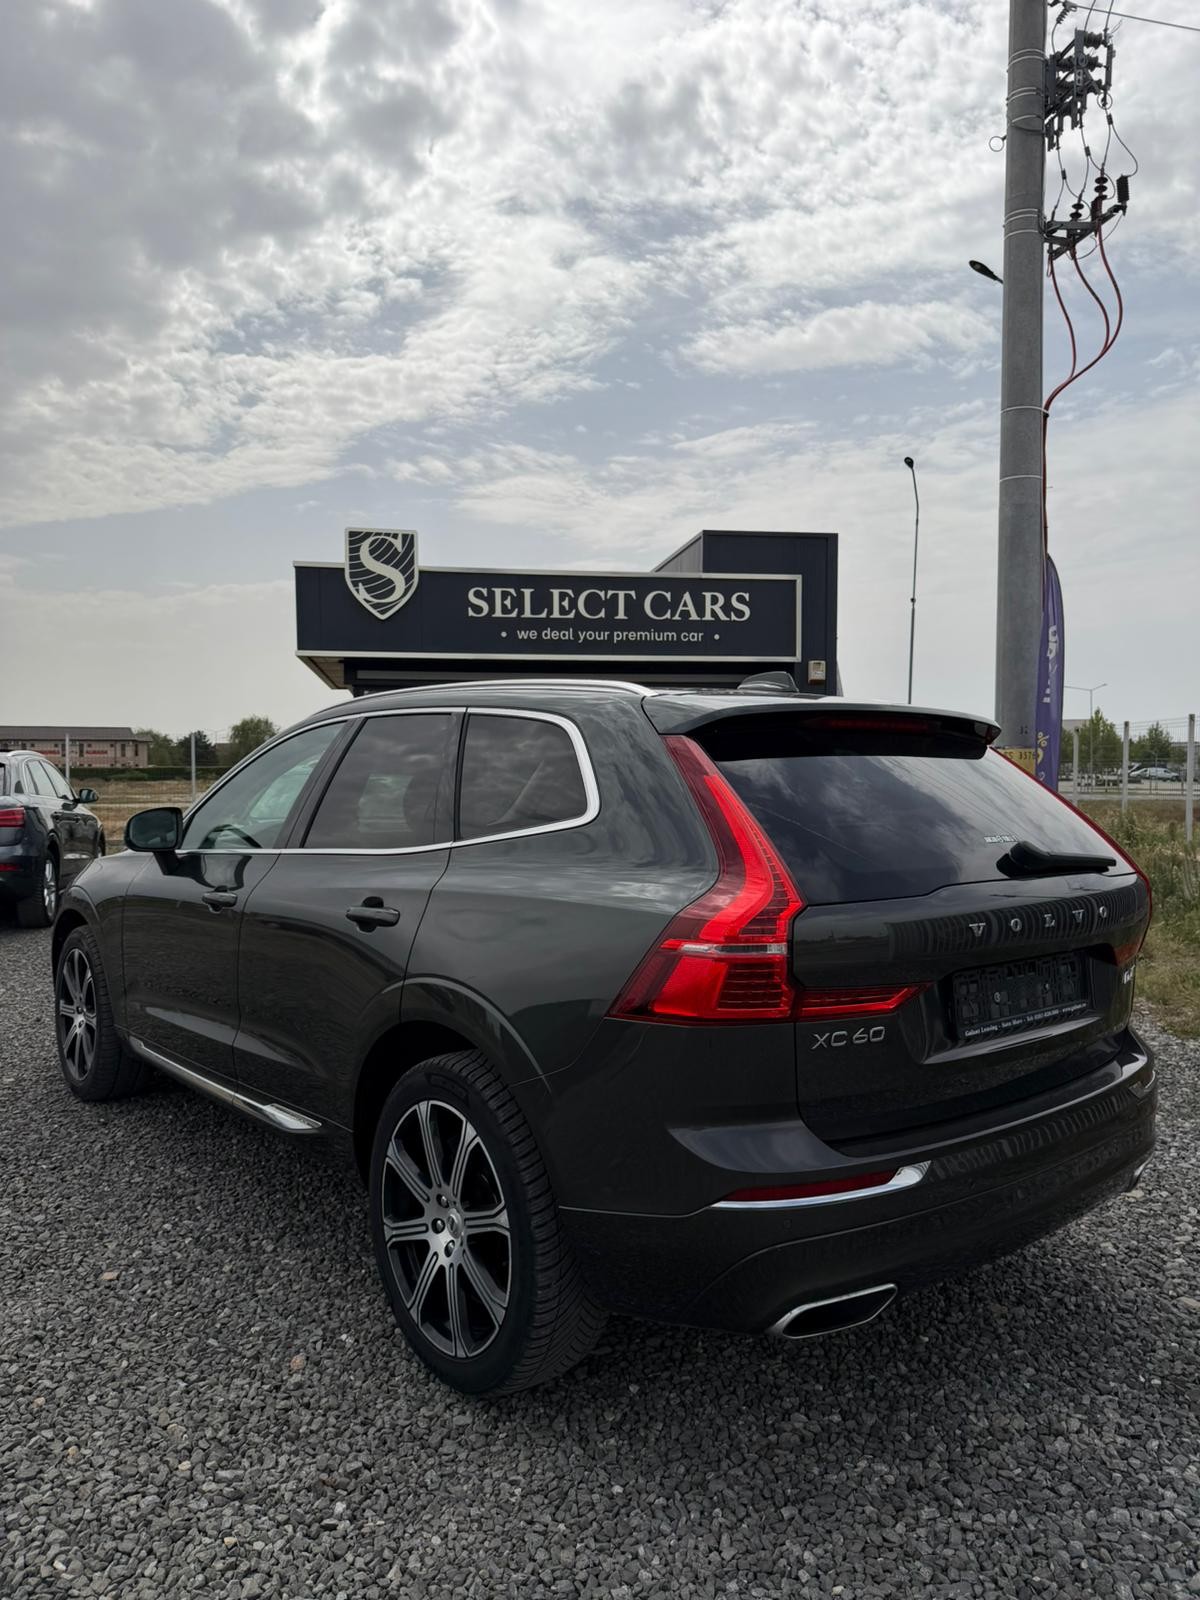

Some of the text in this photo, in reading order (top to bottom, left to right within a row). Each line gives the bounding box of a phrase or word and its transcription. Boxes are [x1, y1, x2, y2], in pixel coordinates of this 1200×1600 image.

[359, 533, 406, 604] S
[467, 586, 752, 622] SELECT CARS
[516, 627, 704, 644] we deal your premium car
[968, 905, 1108, 937] VOLVO
